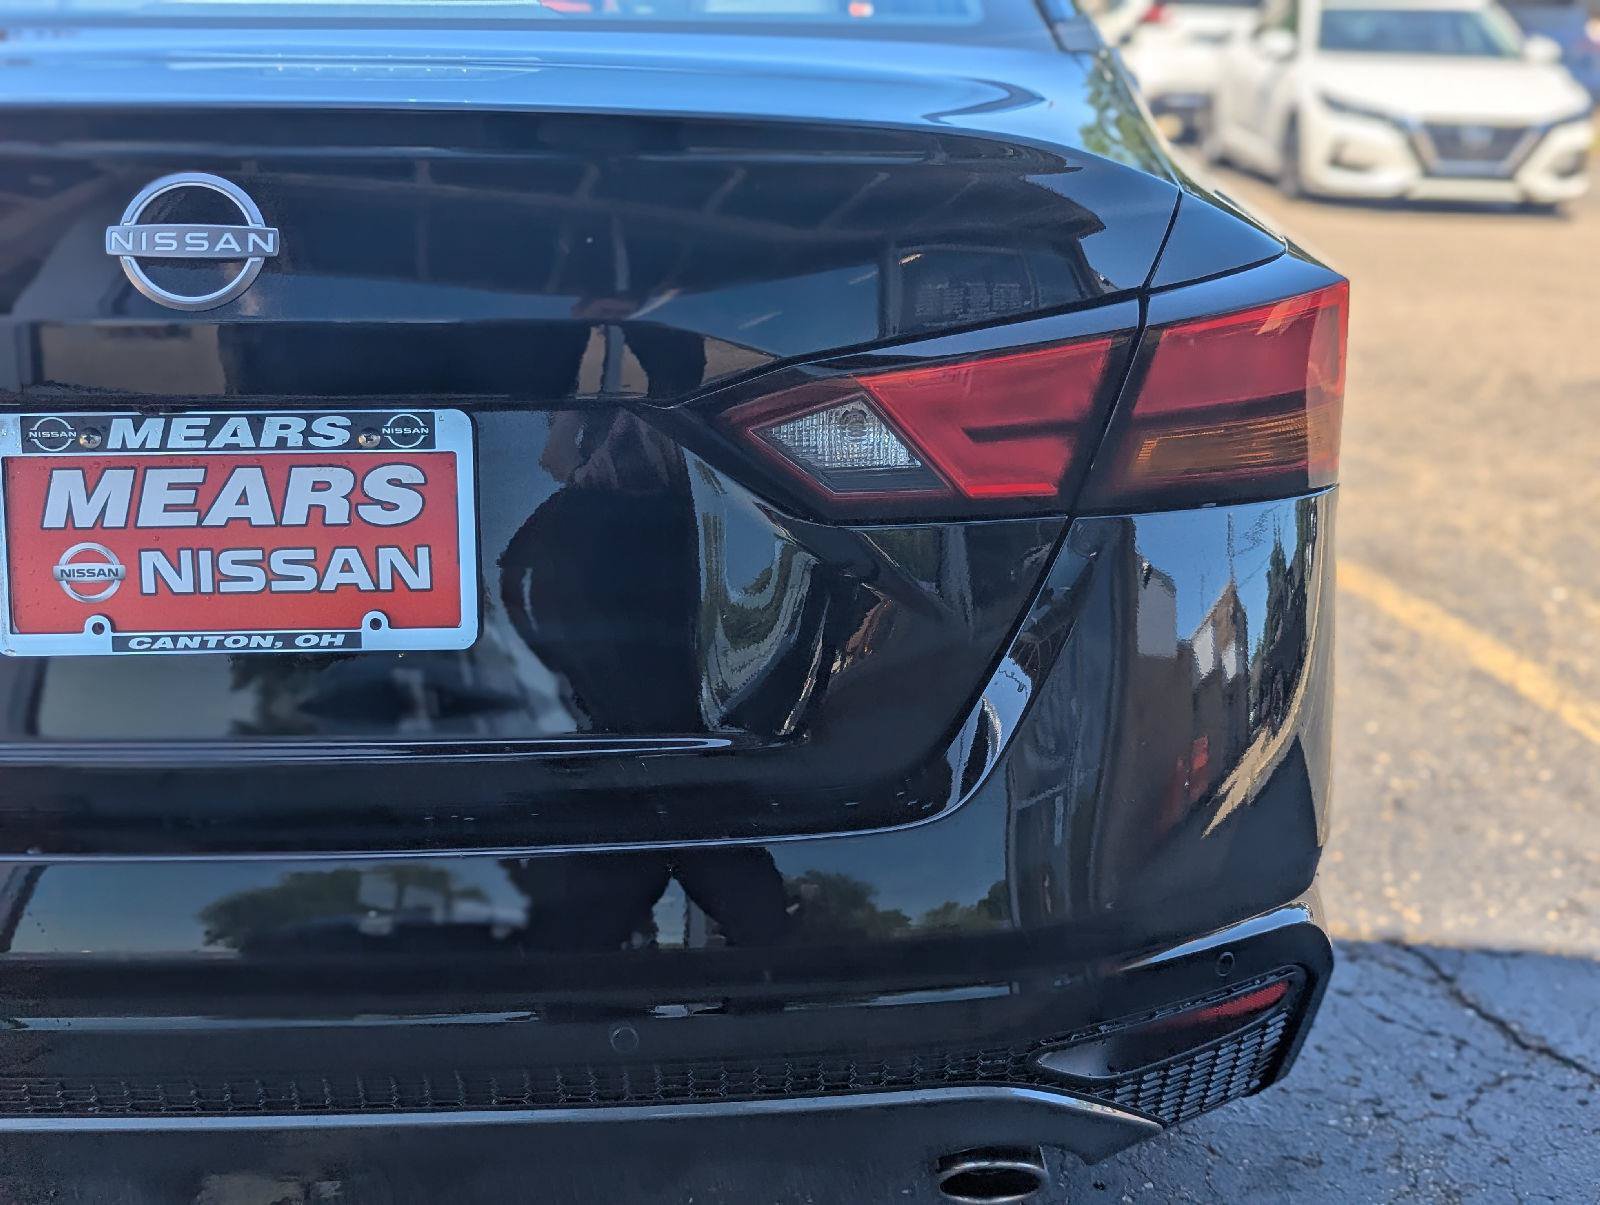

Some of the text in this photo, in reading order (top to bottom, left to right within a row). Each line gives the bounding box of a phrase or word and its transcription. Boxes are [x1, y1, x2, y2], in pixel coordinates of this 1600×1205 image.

[111, 232, 274, 253] NISSAN
[29, 430, 77, 438] NISSAN
[106, 416, 351, 449] MEARS
[42, 463, 427, 529] MEARS
[60, 568, 119, 579] NISSAN
[139, 546, 432, 594] NISSAN
[128, 634, 345, 650] CANTON, OH
